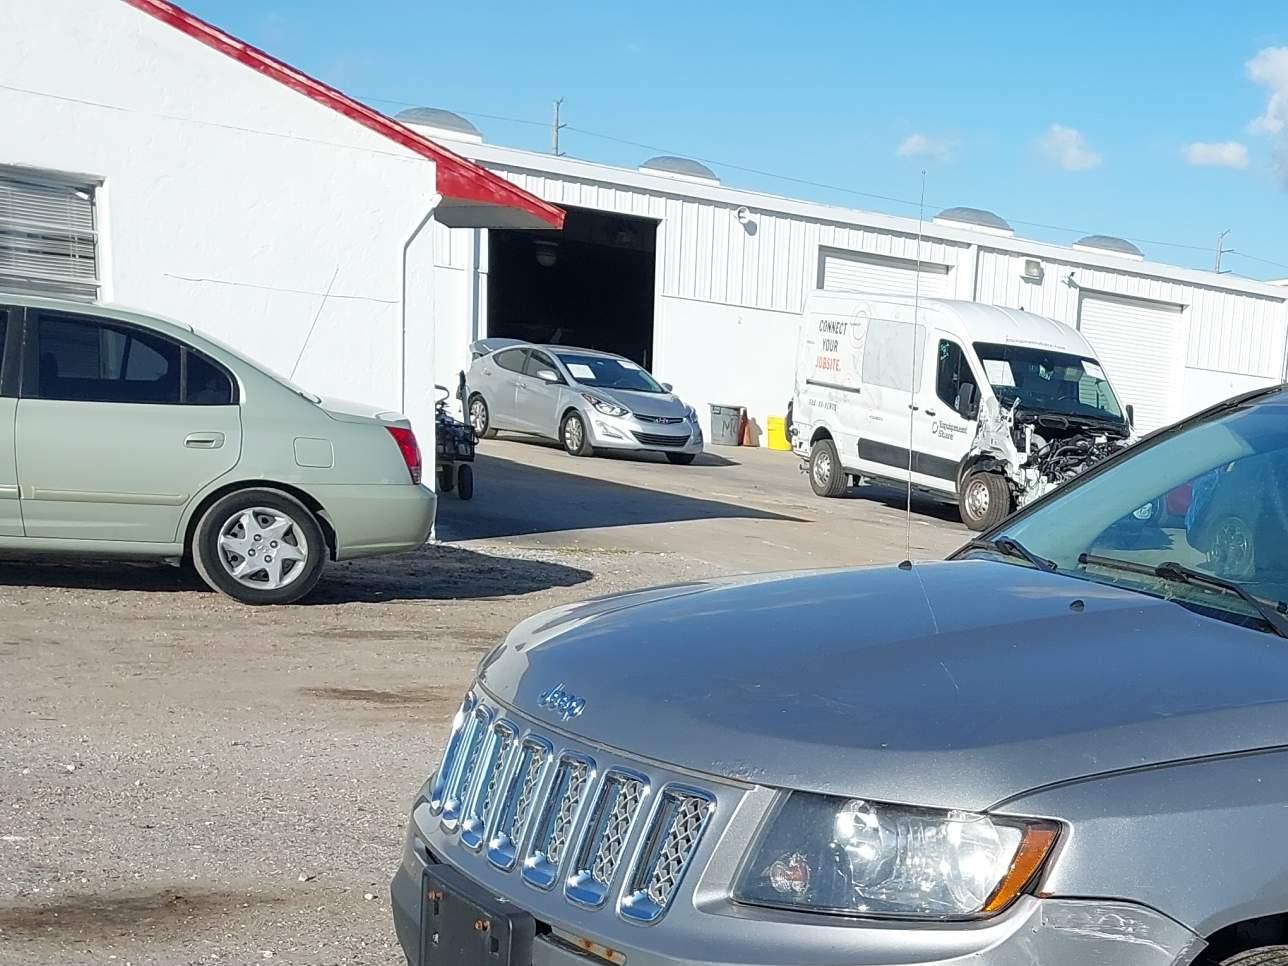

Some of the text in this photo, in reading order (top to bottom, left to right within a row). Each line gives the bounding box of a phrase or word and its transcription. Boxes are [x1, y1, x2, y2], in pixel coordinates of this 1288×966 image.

[818, 319, 848, 335] CONNECT
[822, 338, 839, 352] YOUR
[815, 355, 841, 372] JOBSITE.
[939, 420, 967, 434] Equipment
[537, 682, 586, 722] Jeep
